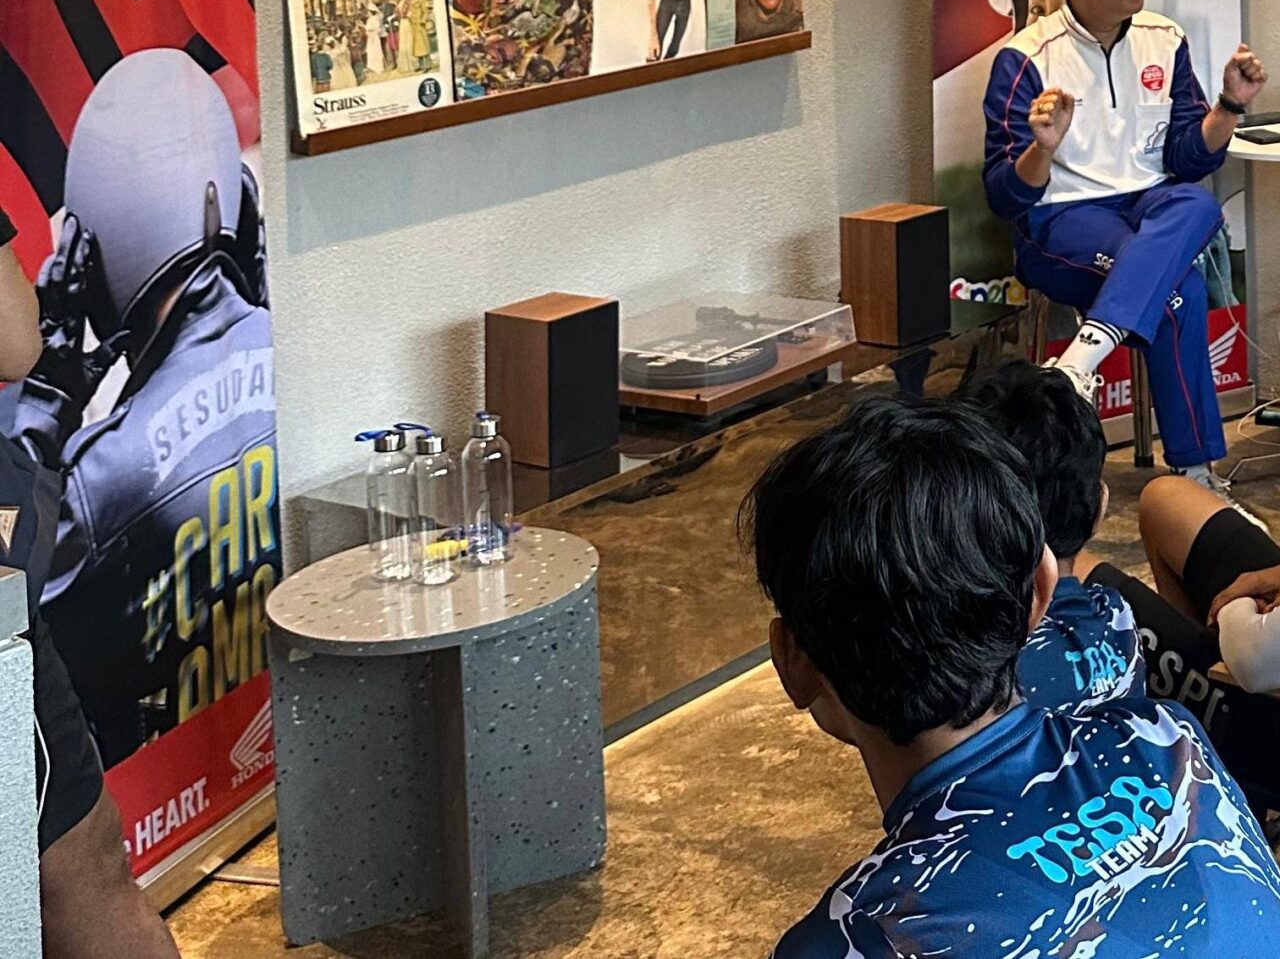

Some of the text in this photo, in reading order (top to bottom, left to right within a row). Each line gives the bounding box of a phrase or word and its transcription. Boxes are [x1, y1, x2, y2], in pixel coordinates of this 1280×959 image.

[313, 94, 367, 115] Strauss
[155, 362, 275, 461] SESUDA
[142, 444, 275, 663] #CAR
[231, 751, 274, 789] HOND
[135, 777, 210, 856] HEART.
[1085, 824, 1159, 881] TEAM
